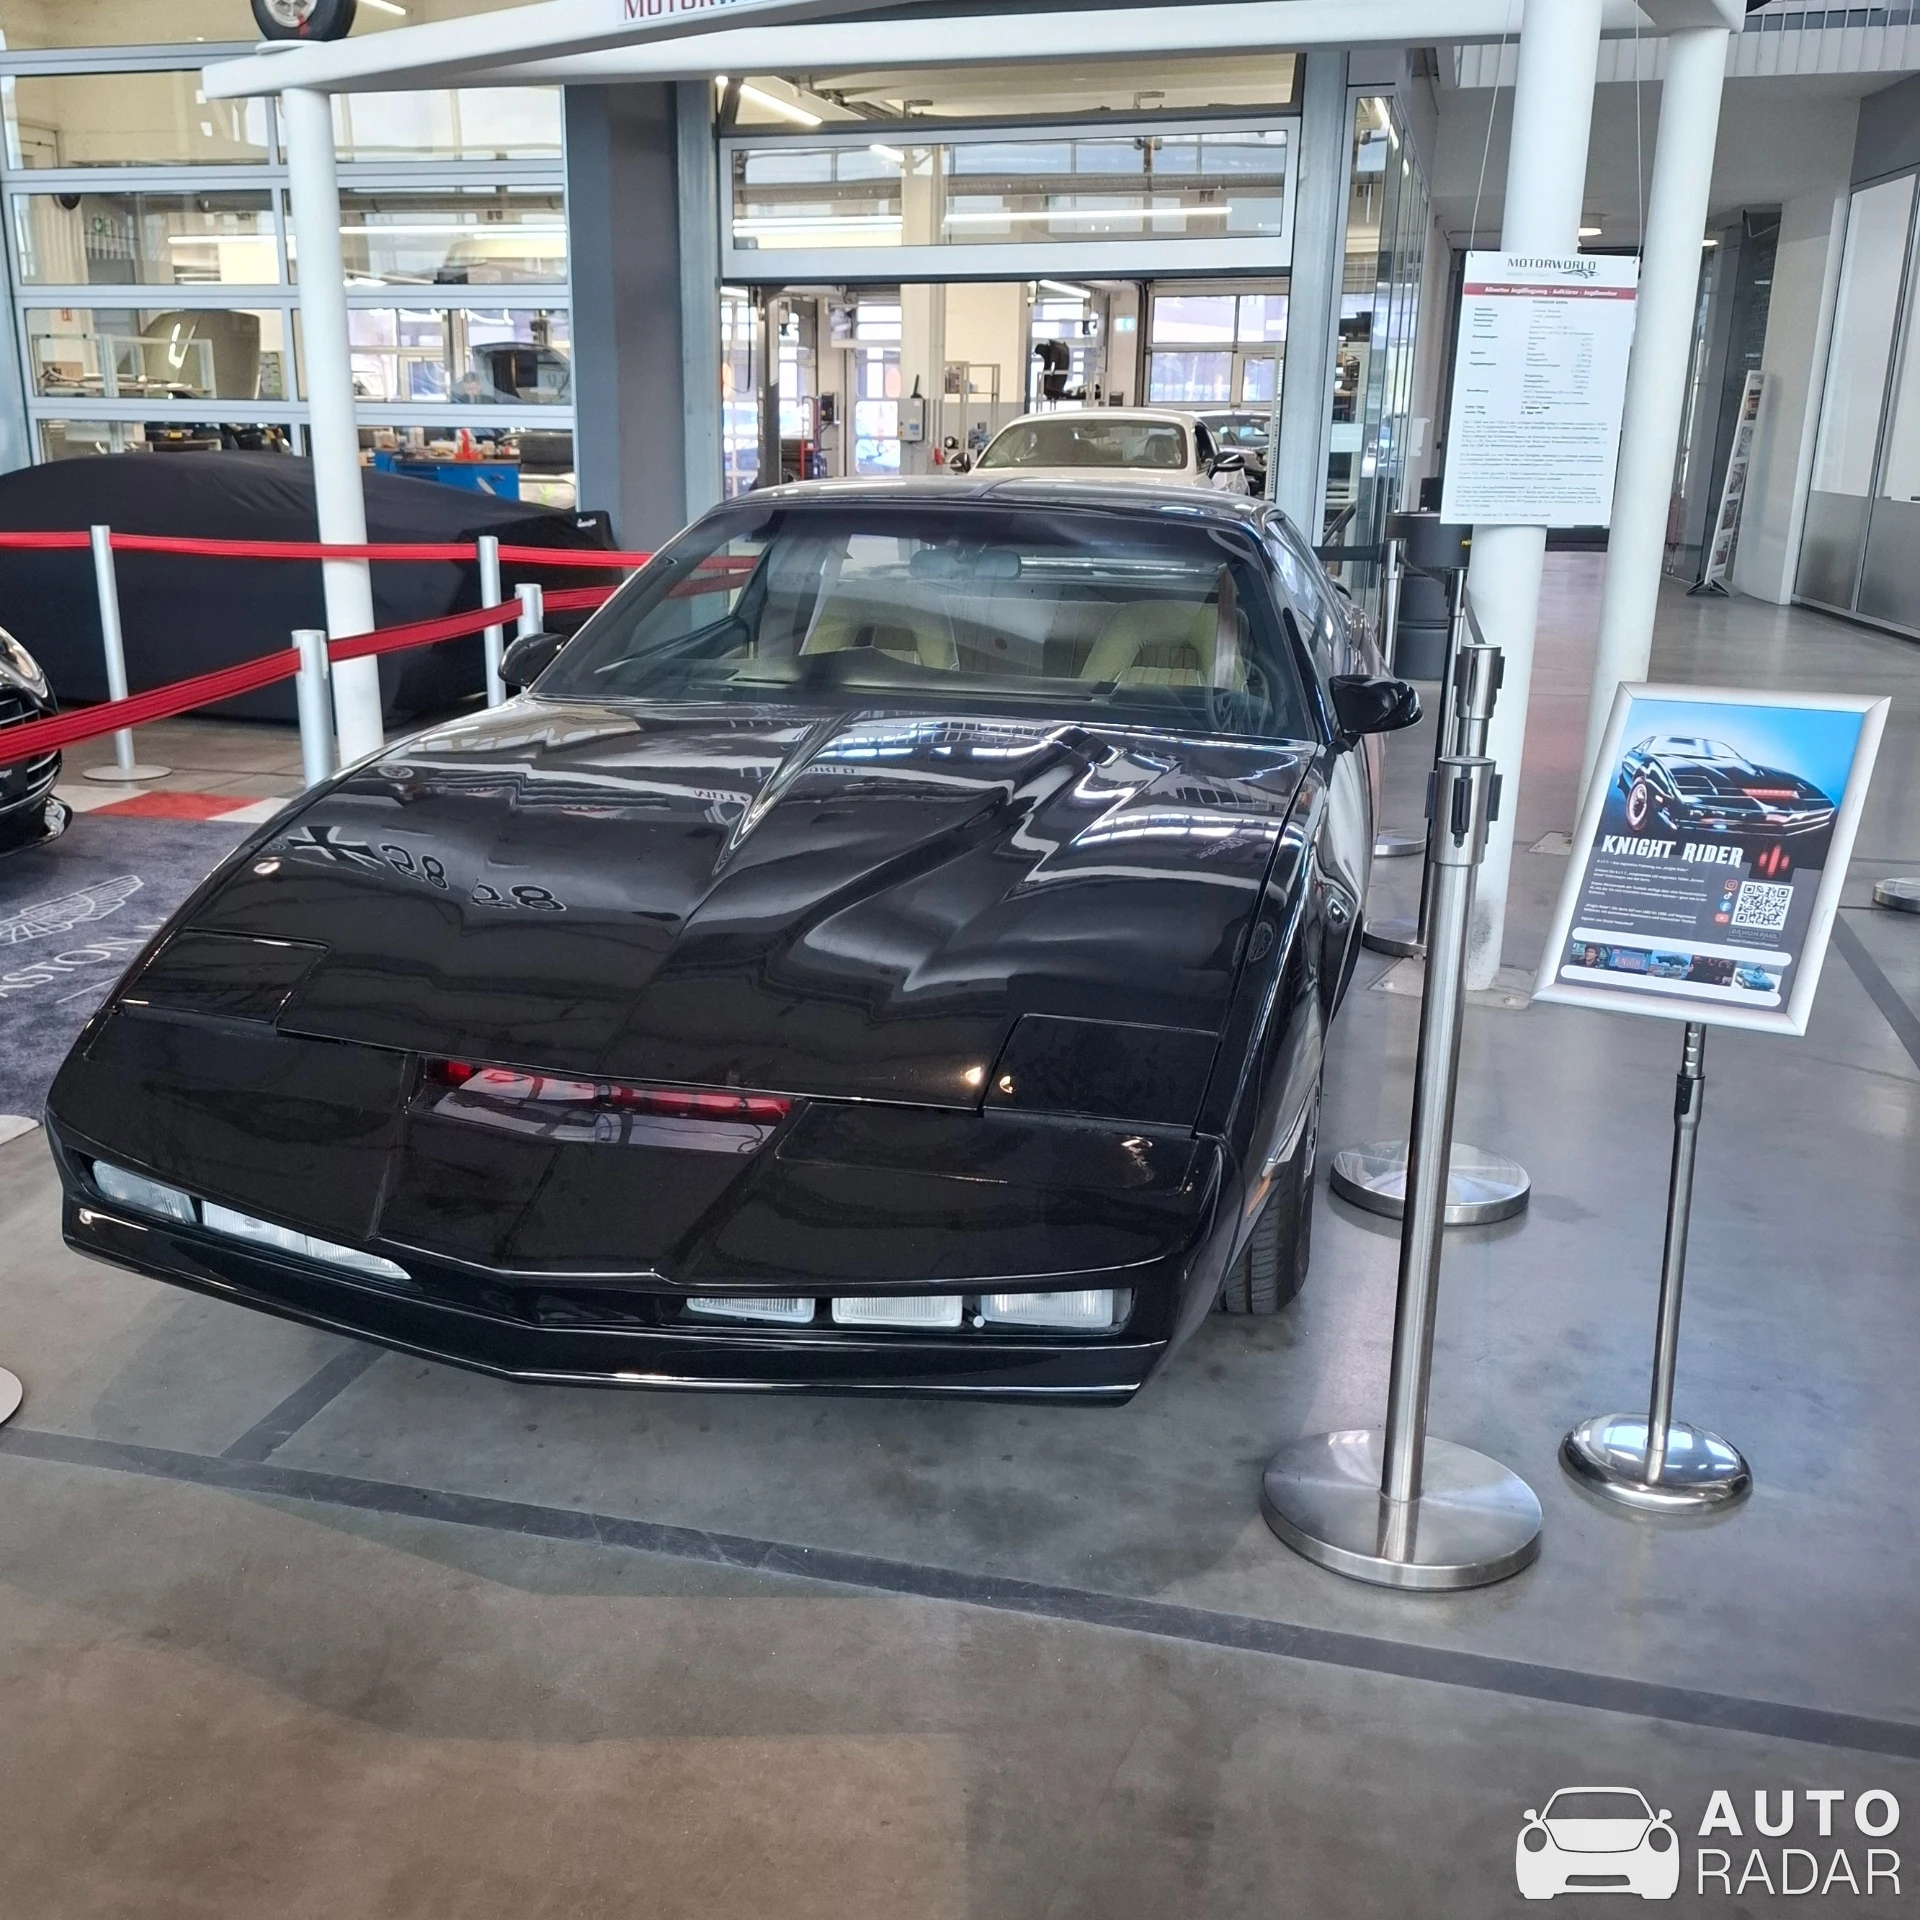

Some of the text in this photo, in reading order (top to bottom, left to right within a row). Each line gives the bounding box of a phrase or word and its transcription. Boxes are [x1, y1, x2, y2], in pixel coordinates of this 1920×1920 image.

[1508, 258, 1597, 270] MOTORWORLD
[1601, 835, 1676, 859] KNIGHT
[1681, 842, 1744, 868] RIDER
